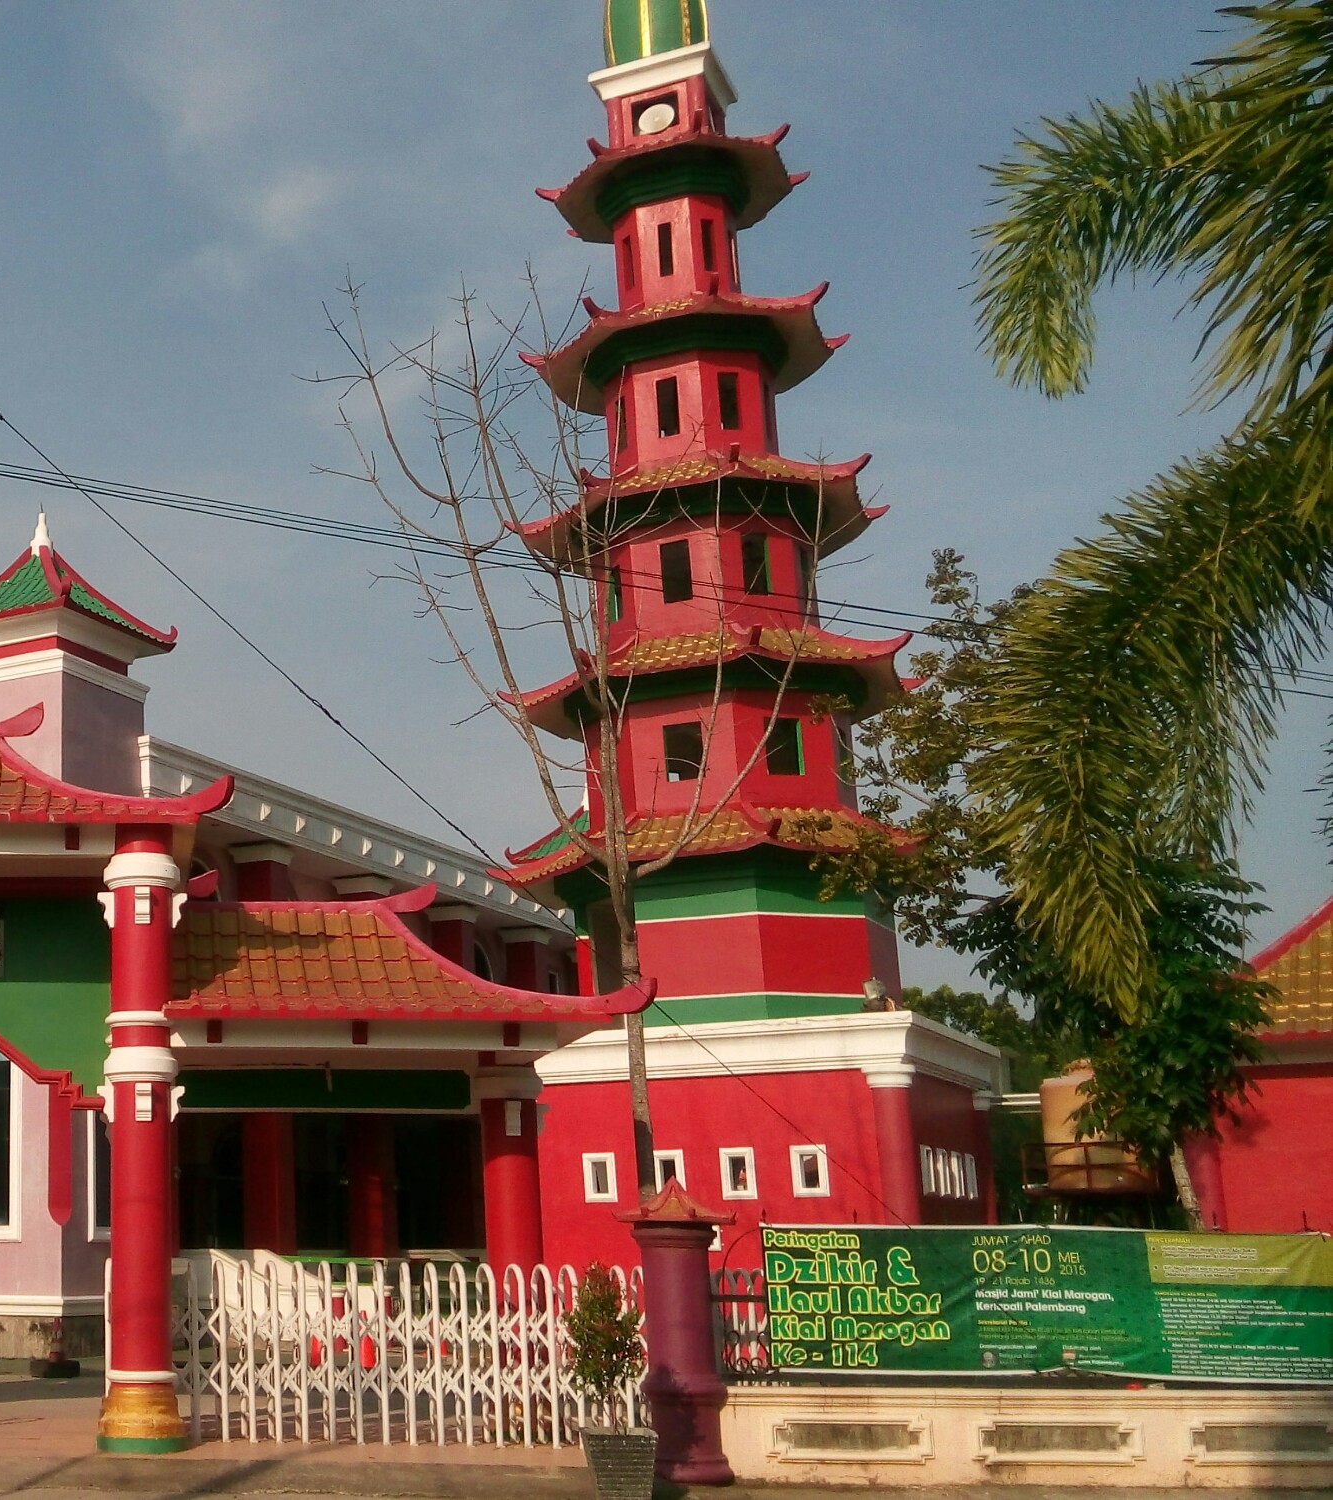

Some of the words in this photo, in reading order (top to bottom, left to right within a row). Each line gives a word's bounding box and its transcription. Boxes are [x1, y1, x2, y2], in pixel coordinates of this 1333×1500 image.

[762, 1229, 860, 1252] Peringatan
[972, 1235, 1009, 1246] JUM'AT
[1020, 1234, 1052, 1245] AHAD
[1058, 1251, 1081, 1264] MEI
[764, 1250, 878, 1285] Dzikir
[886, 1246, 921, 1286] &
[1059, 1264, 1087, 1276] 2015
[973, 1277, 986, 1286] 19
[992, 1276, 1003, 1285] 21
[1005, 1276, 1031, 1286] Rajab
[1034, 1276, 1056, 1286] 1436
[767, 1285, 842, 1314] Haul
[848, 1285, 942, 1315] Akbar
[975, 1288, 1009, 1299] Masjid
[1011, 1288, 1039, 1298] Jami'
[1041, 1289, 1062, 1299] Kiai
[1064, 1289, 1115, 1302] Marogan,
[1025, 1302, 1086, 1315] Palembang
[769, 1315, 826, 1341] Kiai
[831, 1316, 951, 1346] Marogan
[770, 1343, 808, 1368] Ke
[831, 1342, 879, 1367] 114
